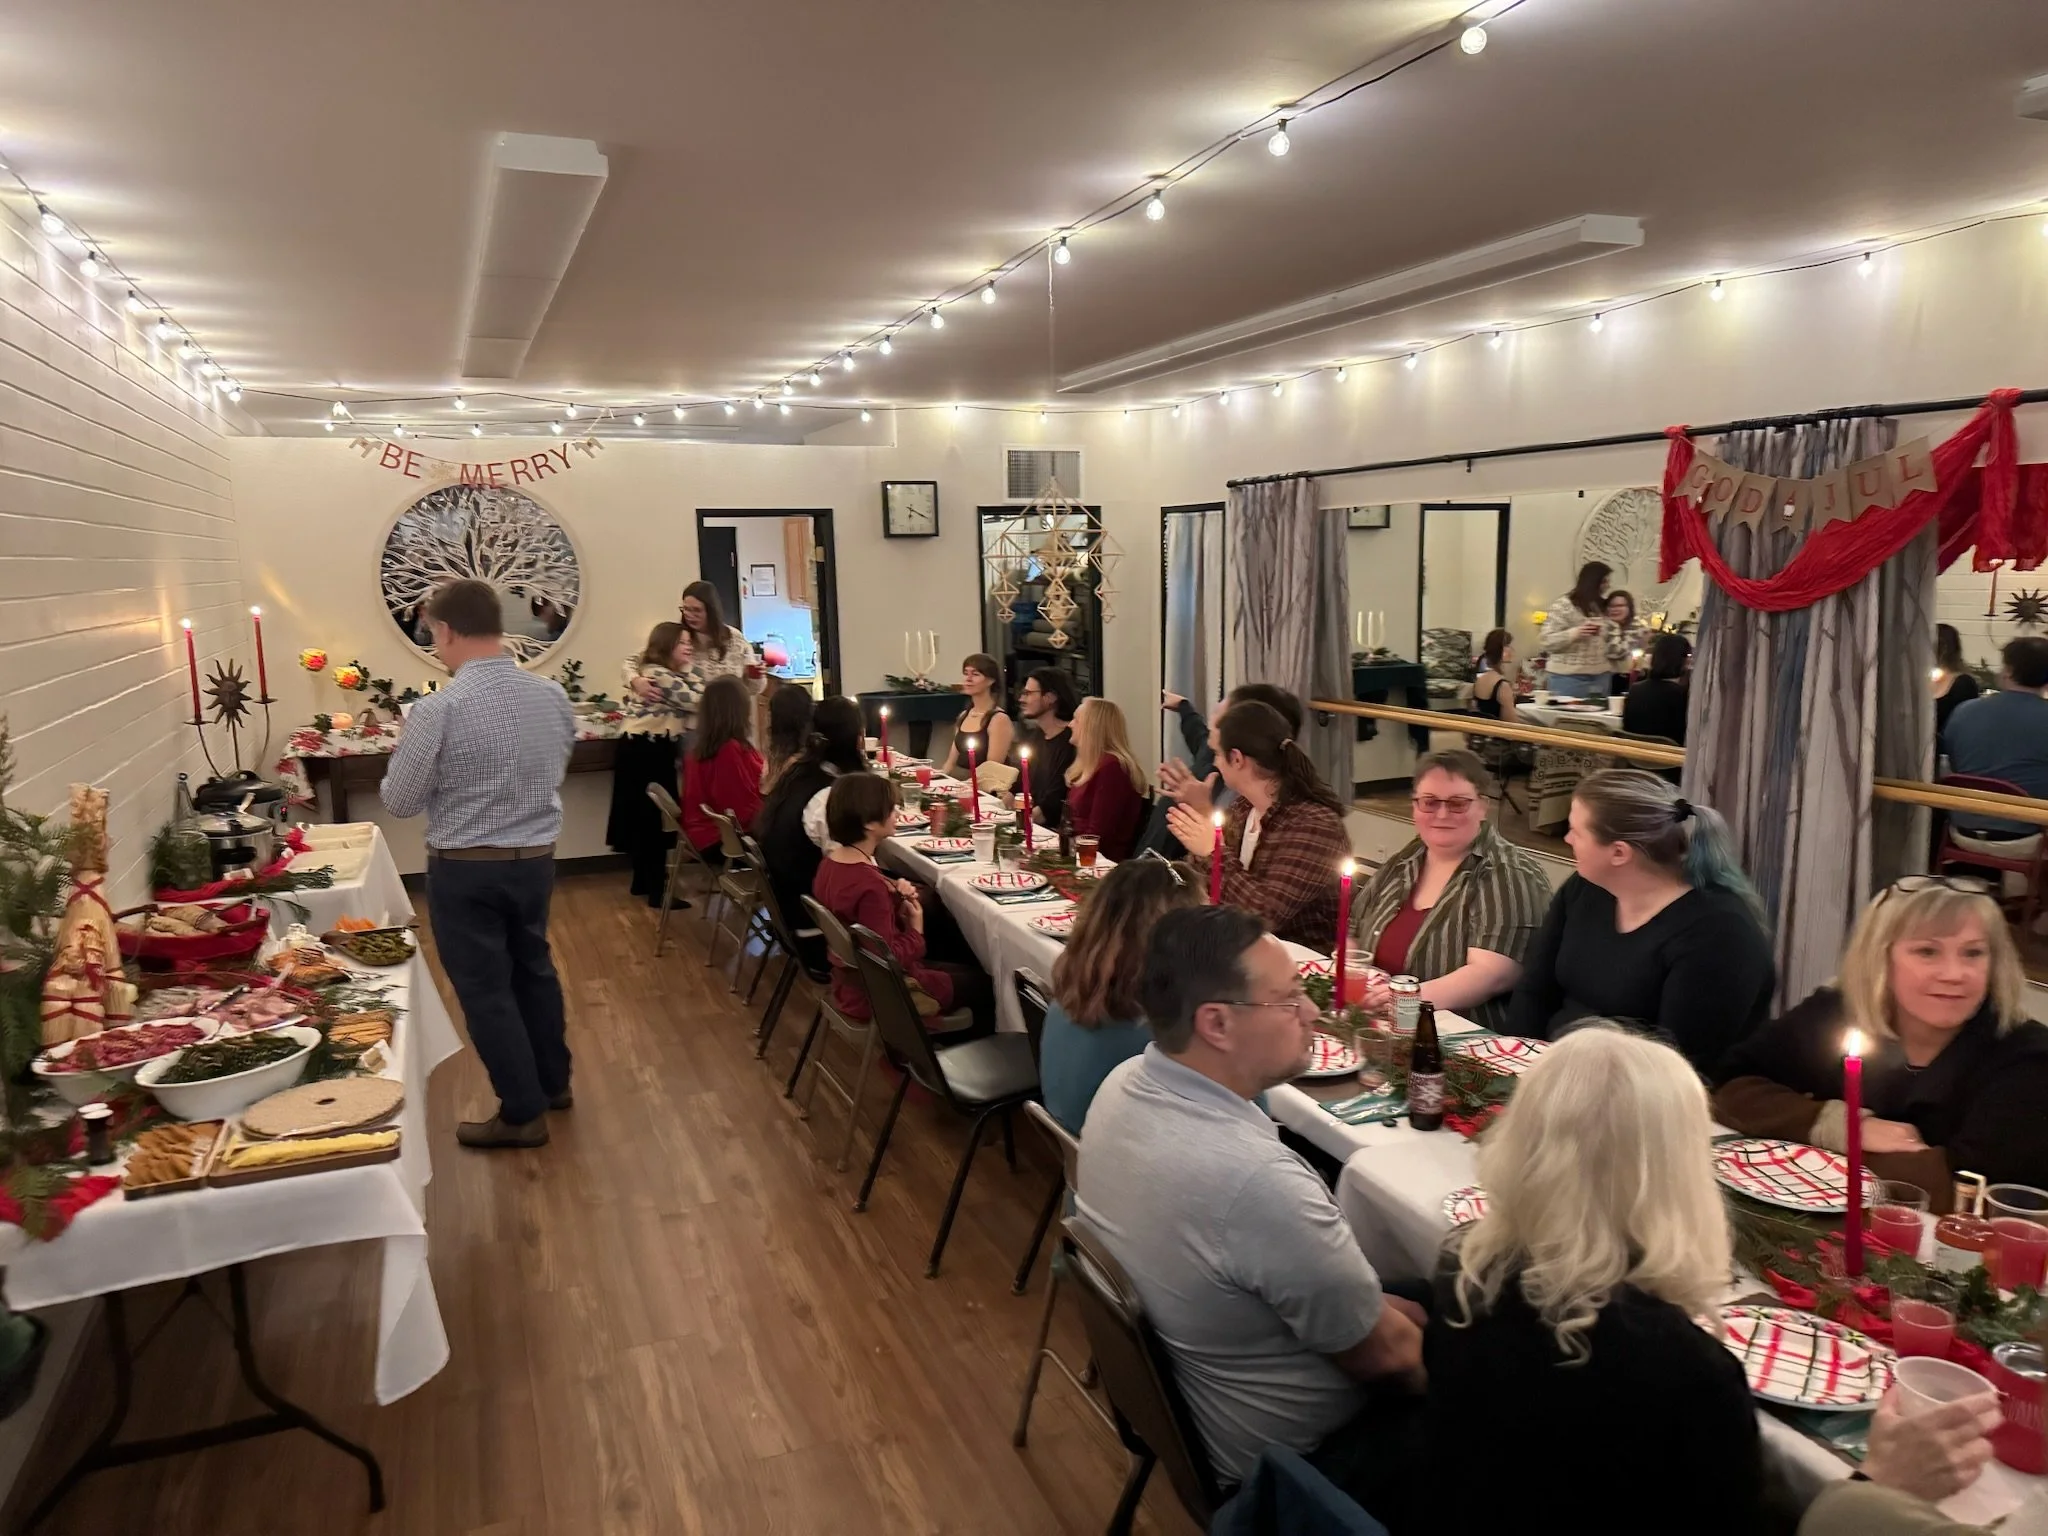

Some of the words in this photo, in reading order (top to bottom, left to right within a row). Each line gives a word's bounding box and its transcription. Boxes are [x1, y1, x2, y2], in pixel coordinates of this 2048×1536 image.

[379, 442, 425, 479] BE
[459, 443, 572, 490] MERRY
[1691, 464, 1764, 514] GOD
[1824, 454, 1924, 511] JUL
